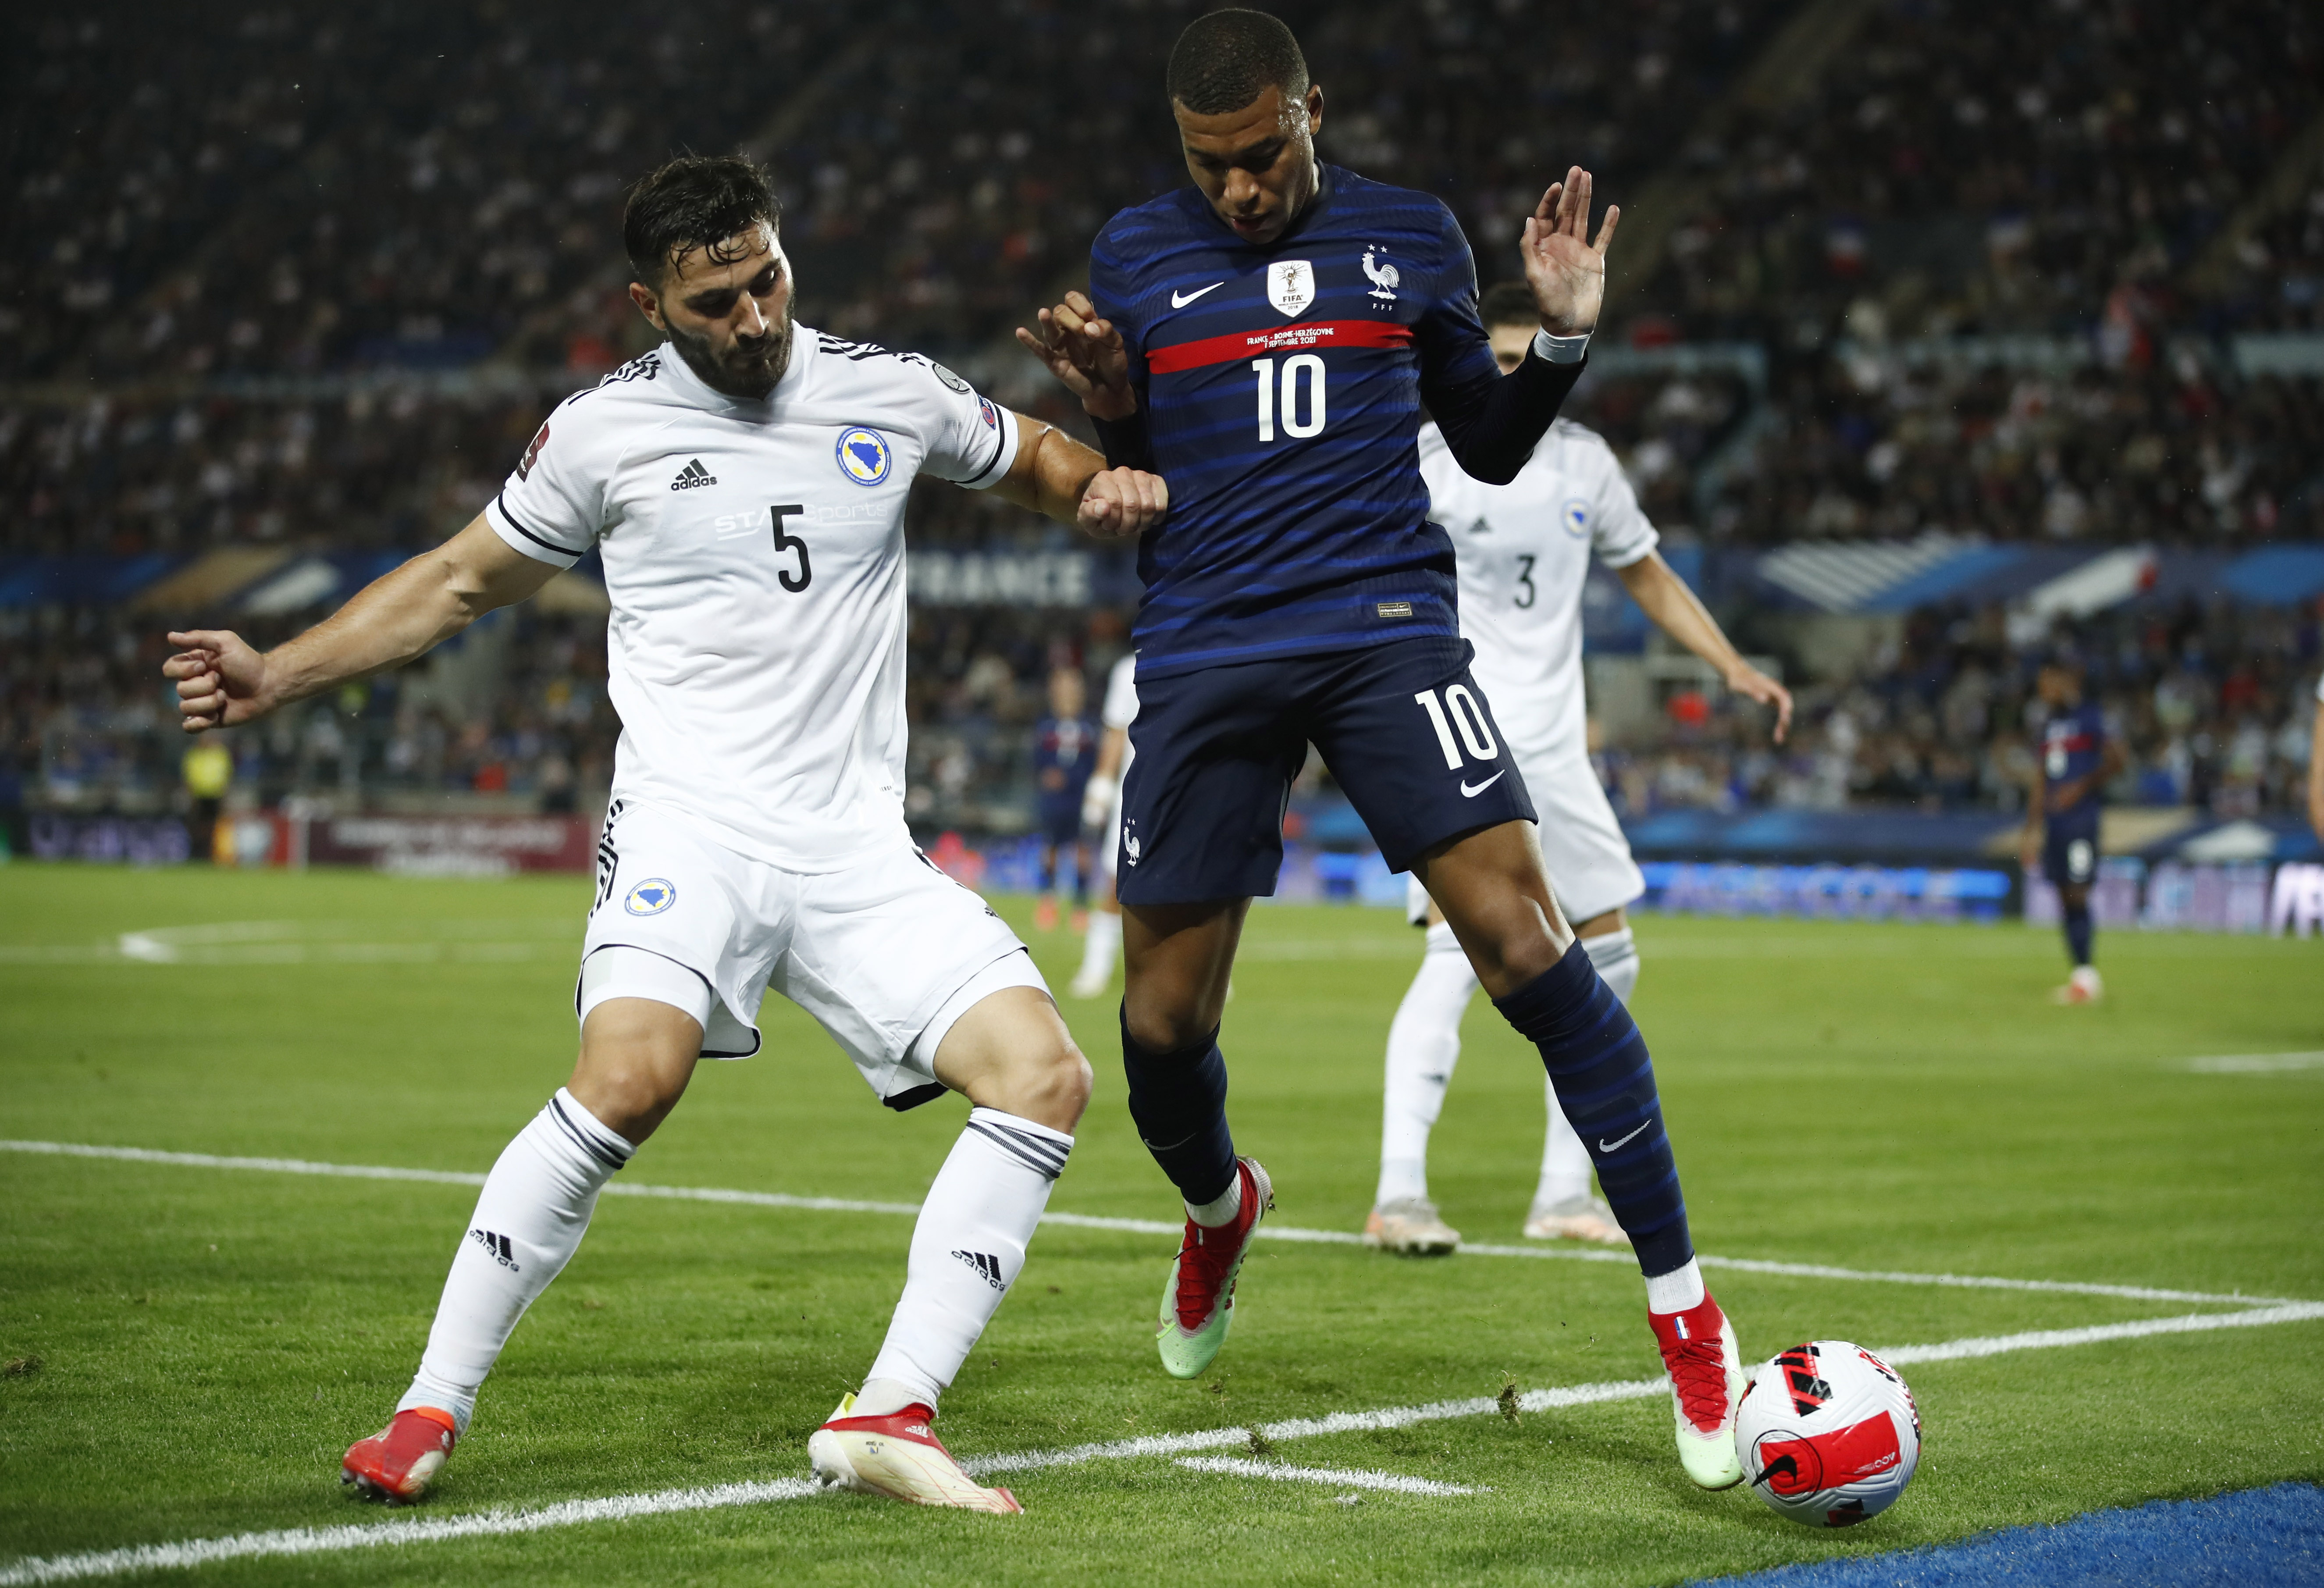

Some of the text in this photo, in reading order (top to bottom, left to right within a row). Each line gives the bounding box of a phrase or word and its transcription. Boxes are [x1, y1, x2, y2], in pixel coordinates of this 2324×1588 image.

[1247, 335, 1268, 345] FRANCE
[1269, 338, 1298, 348] SEPTEMBRE
[1252, 354, 1326, 442] 10
[671, 476, 718, 491] adidas
[770, 504, 812, 593] 5
[1514, 553, 1537, 609] 3
[1414, 684, 1498, 770] 10
[470, 1230, 520, 1272] adidas
[951, 1251, 1006, 1291] adidas
